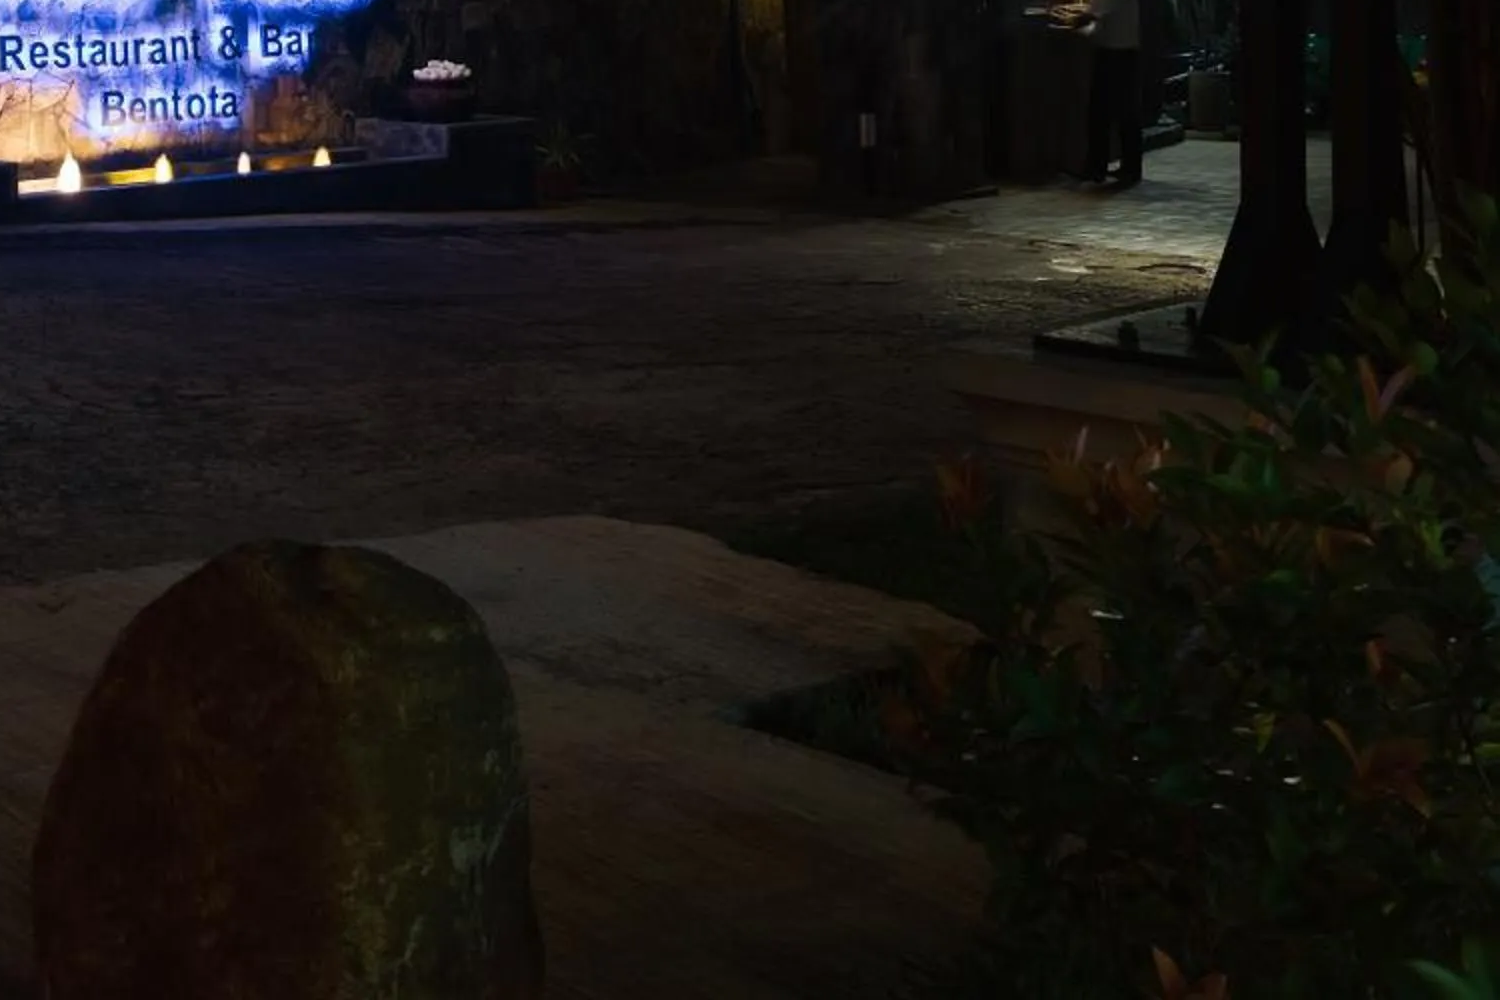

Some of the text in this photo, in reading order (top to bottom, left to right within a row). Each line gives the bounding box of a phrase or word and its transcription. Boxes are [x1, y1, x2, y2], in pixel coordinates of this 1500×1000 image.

[218, 25, 243, 61] &
[261, 23, 319, 58] Bar
[101, 85, 239, 128] Bentota
